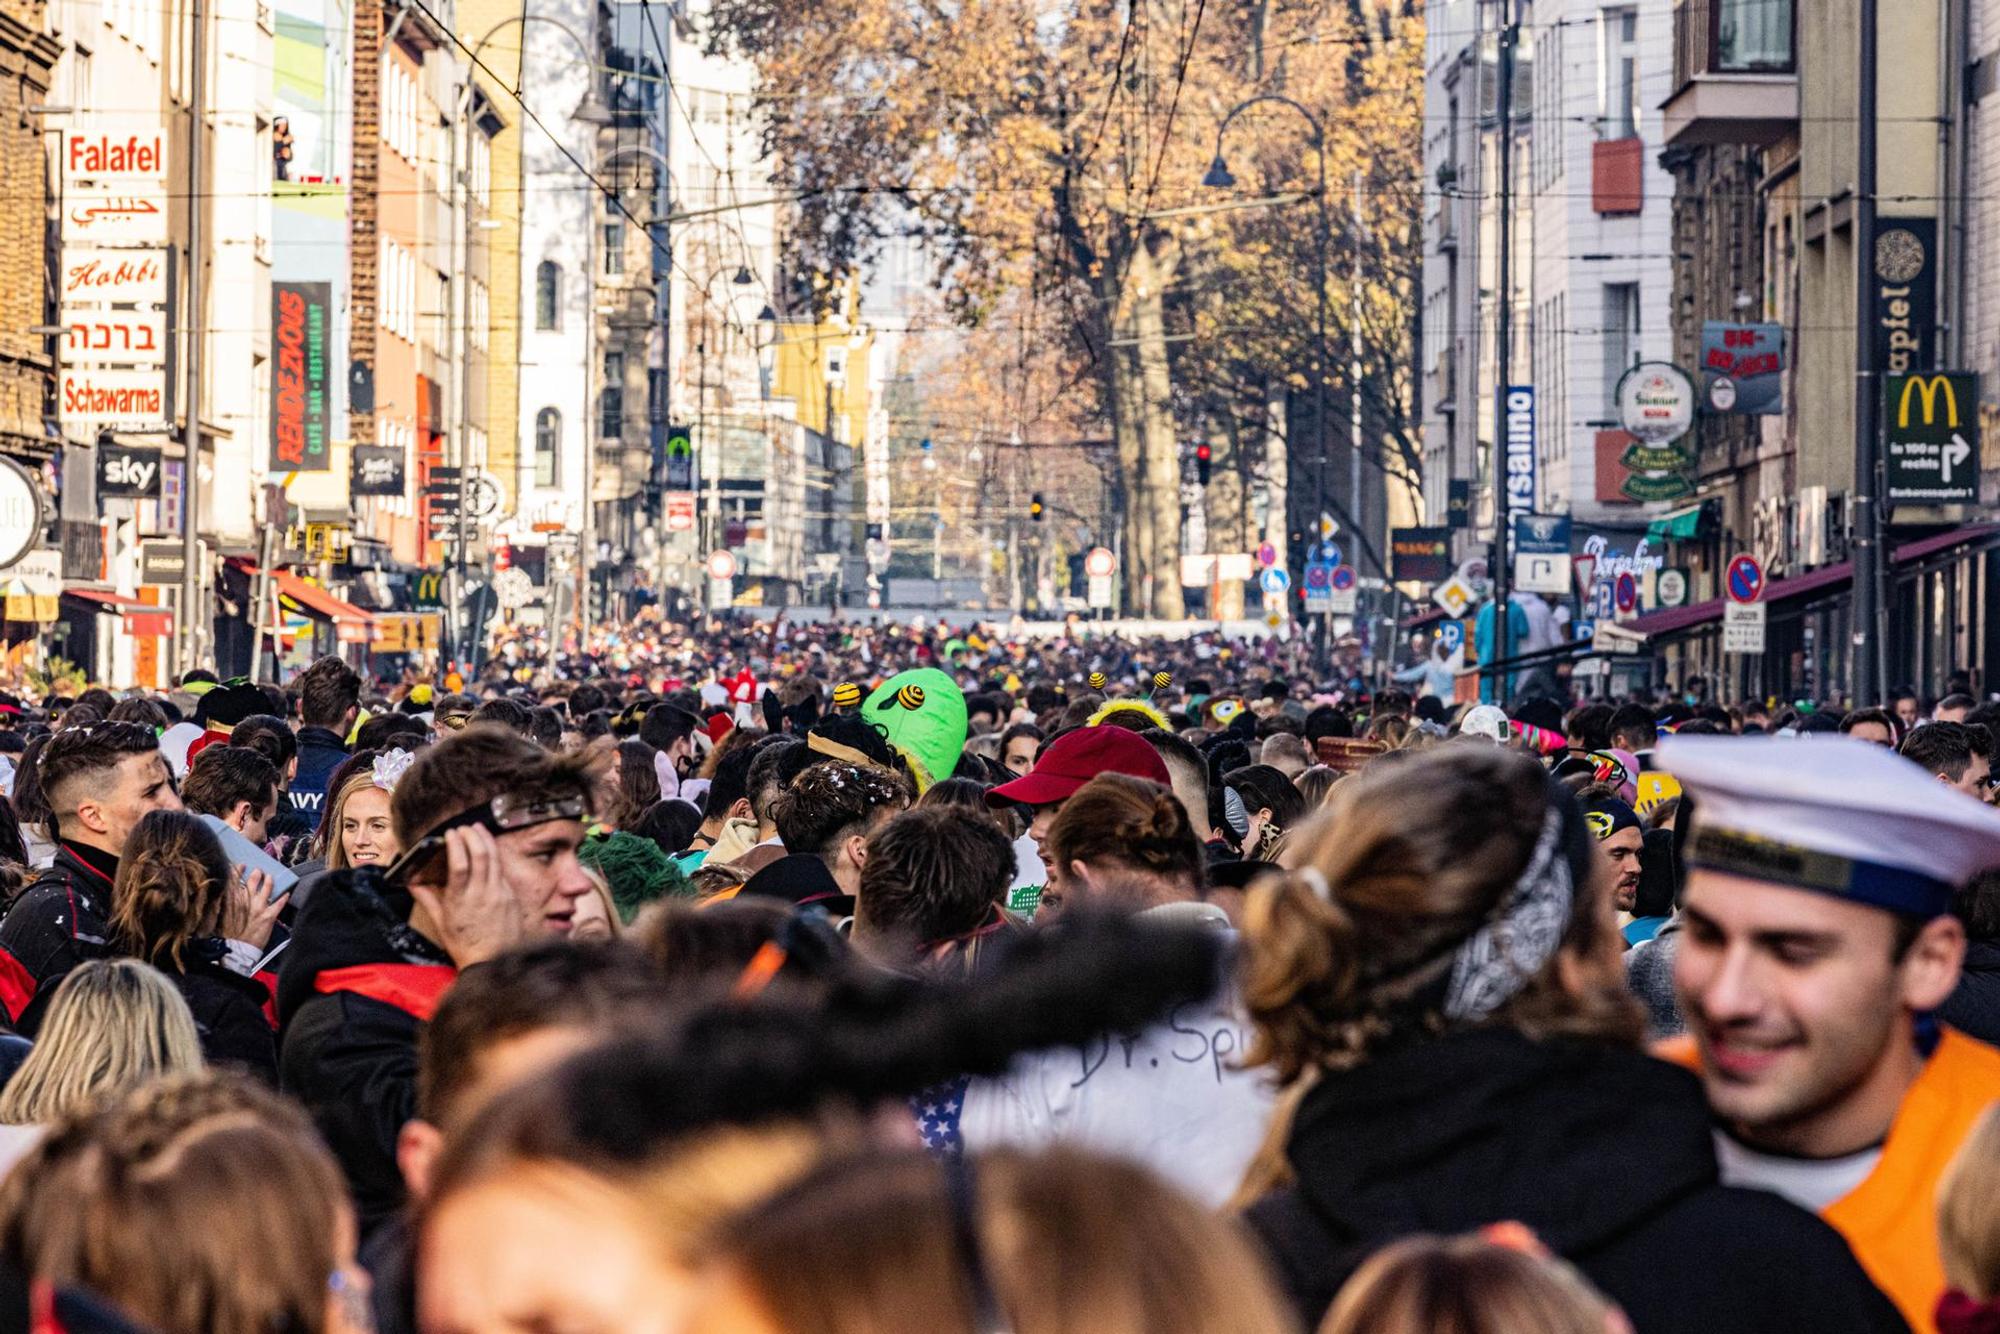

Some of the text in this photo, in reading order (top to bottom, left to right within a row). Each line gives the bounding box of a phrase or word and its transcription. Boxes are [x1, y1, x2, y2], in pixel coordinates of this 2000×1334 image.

[70, 136, 160, 172] Falafel
[67, 258, 158, 292] Habibi
[69, 324, 156, 350] ברכה
[307, 303, 324, 381] RESTAURANT
[277, 289, 305, 465] RENDEZVOUS
[65, 377, 161, 414] Schawarma
[1890, 442, 1940, 455] in 100 m
[1901, 457, 1940, 470] rechts
[104, 455, 156, 490] sky
[289, 792, 324, 810] AVY
